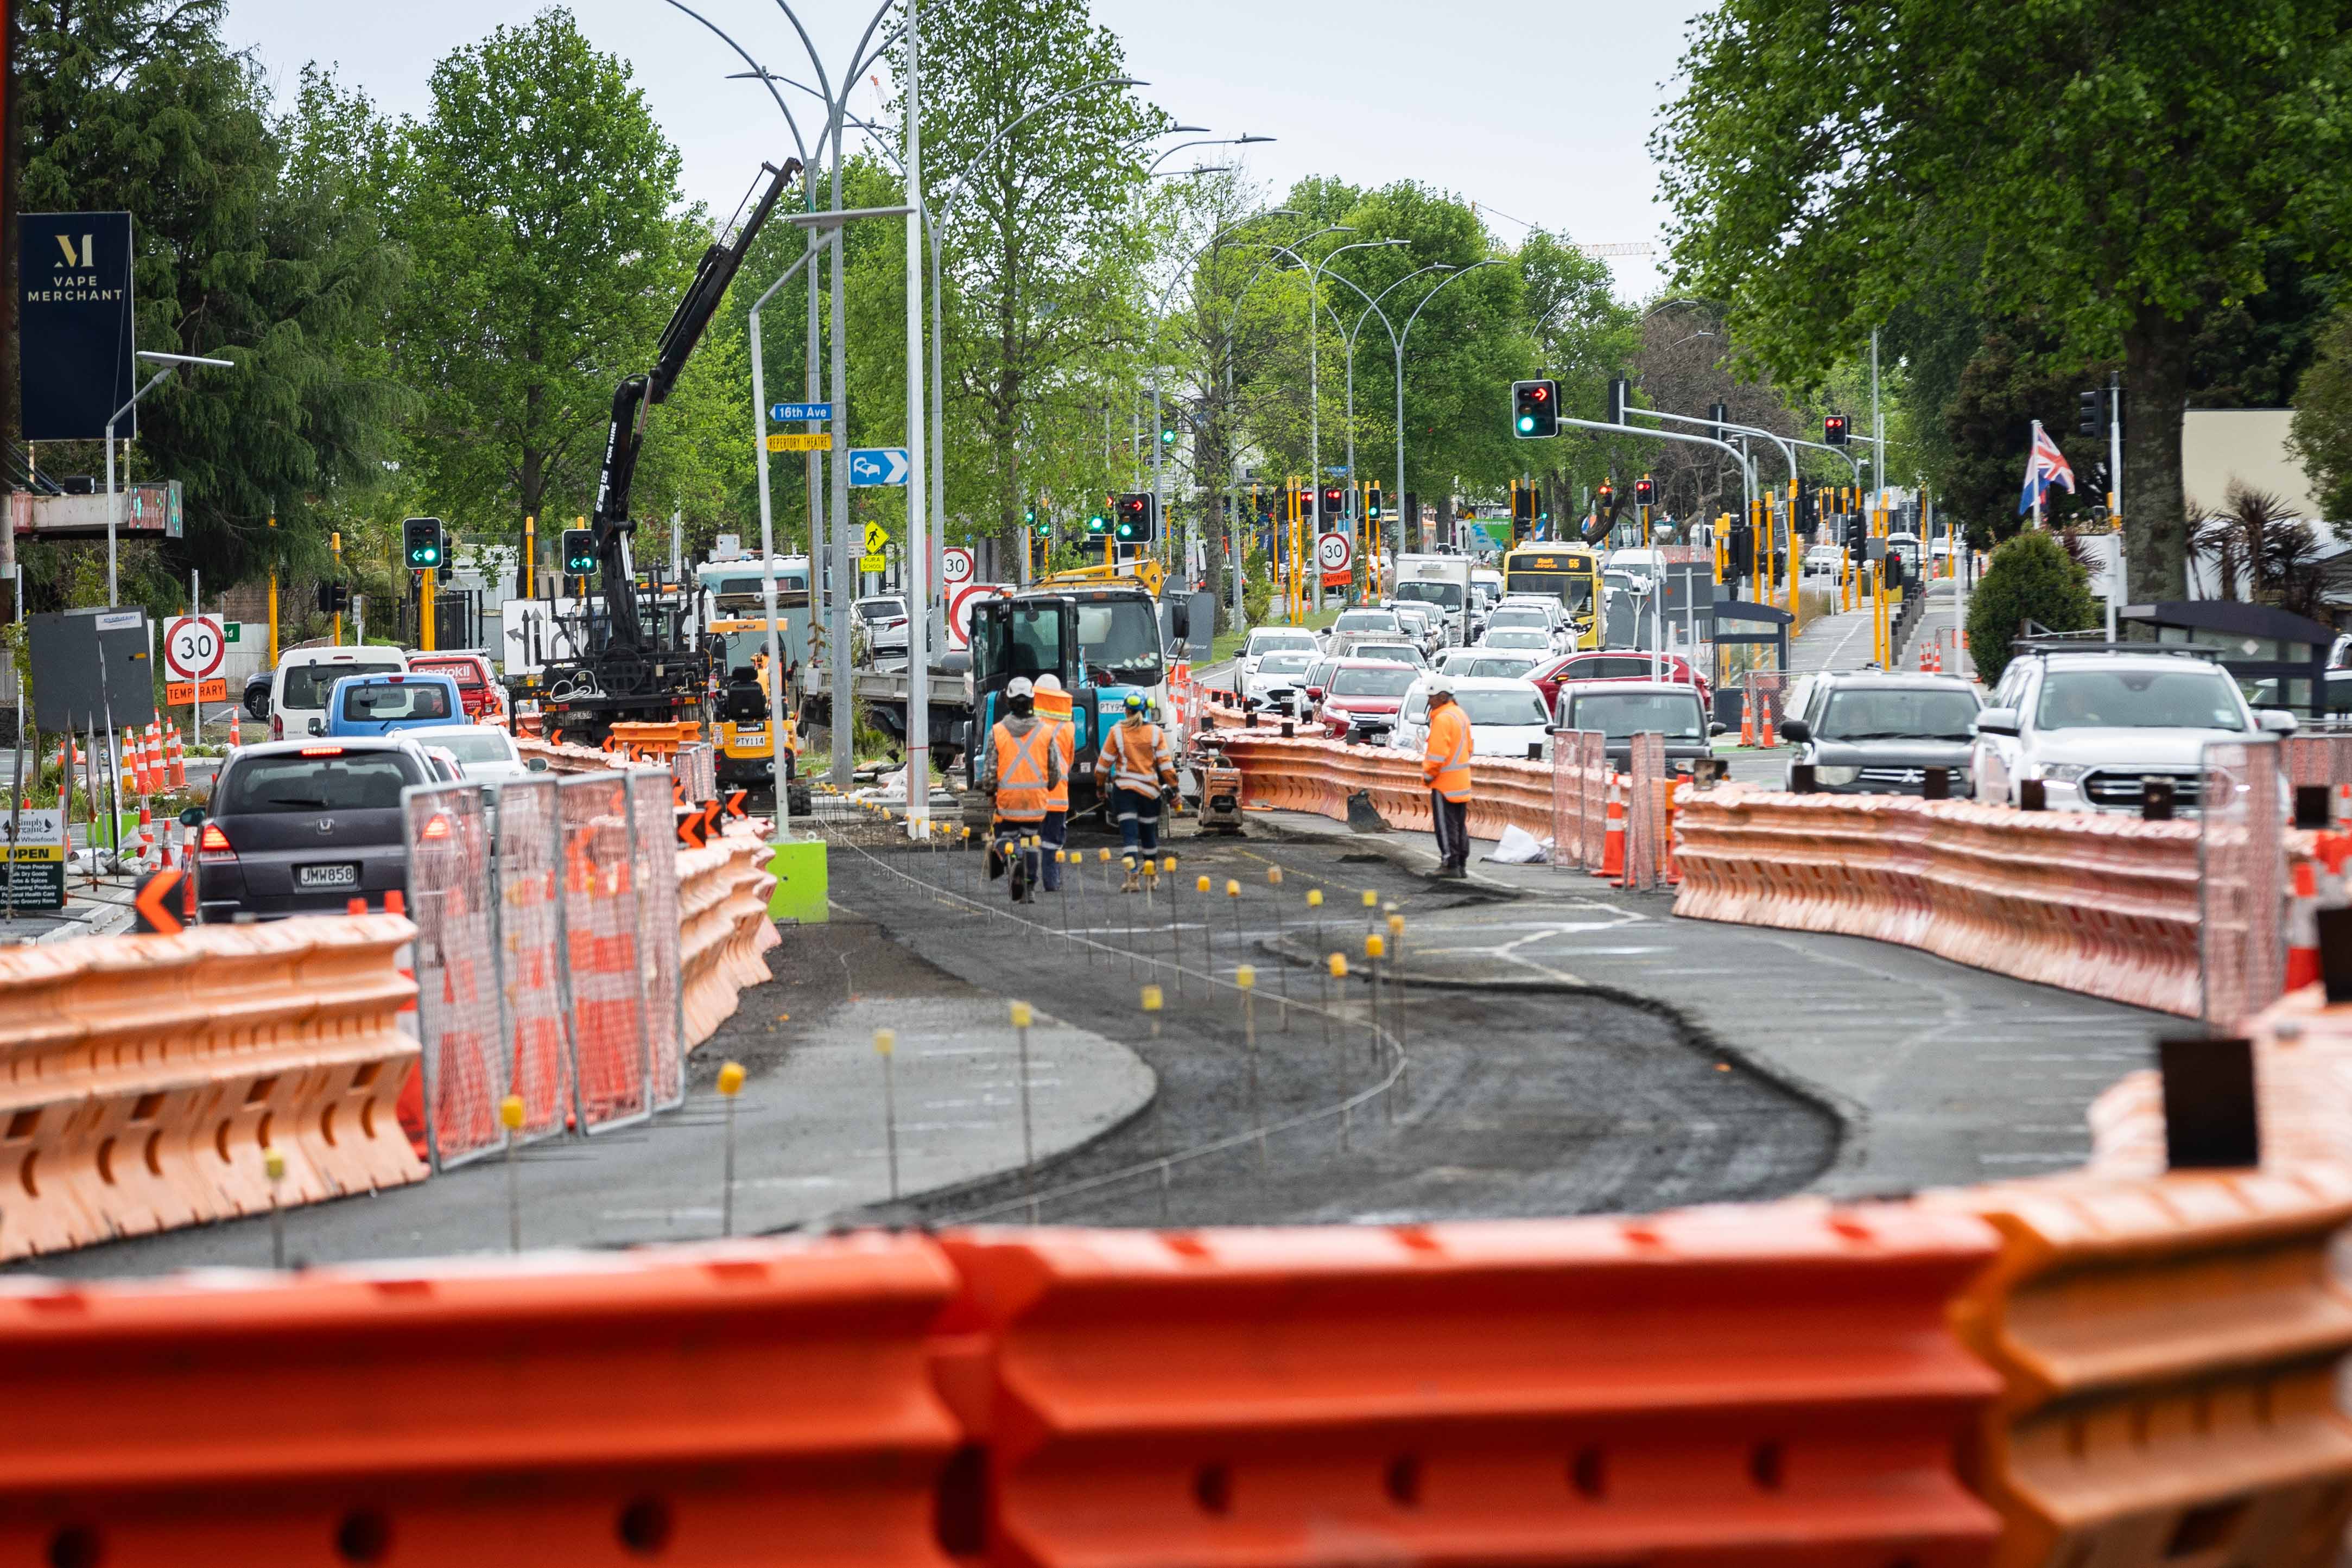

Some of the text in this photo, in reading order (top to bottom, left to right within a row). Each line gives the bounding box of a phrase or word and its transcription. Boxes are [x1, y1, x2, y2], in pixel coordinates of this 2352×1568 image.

[54, 276, 97, 287] VAPE
[28, 289, 122, 302] MERCHANT
[779, 407, 827, 418] 16th Ave
[609, 421, 617, 444] HIRE
[769, 436, 827, 449] REPERTORY THEATRE
[606, 445, 614, 464] FOR
[1324, 544, 1342, 558] 30
[945, 558, 965, 573] 30
[181, 634, 212, 659] 30
[169, 684, 224, 700] TEMPRARY
[7, 849, 49, 859] OPEN
[303, 868, 353, 882] JMW858
